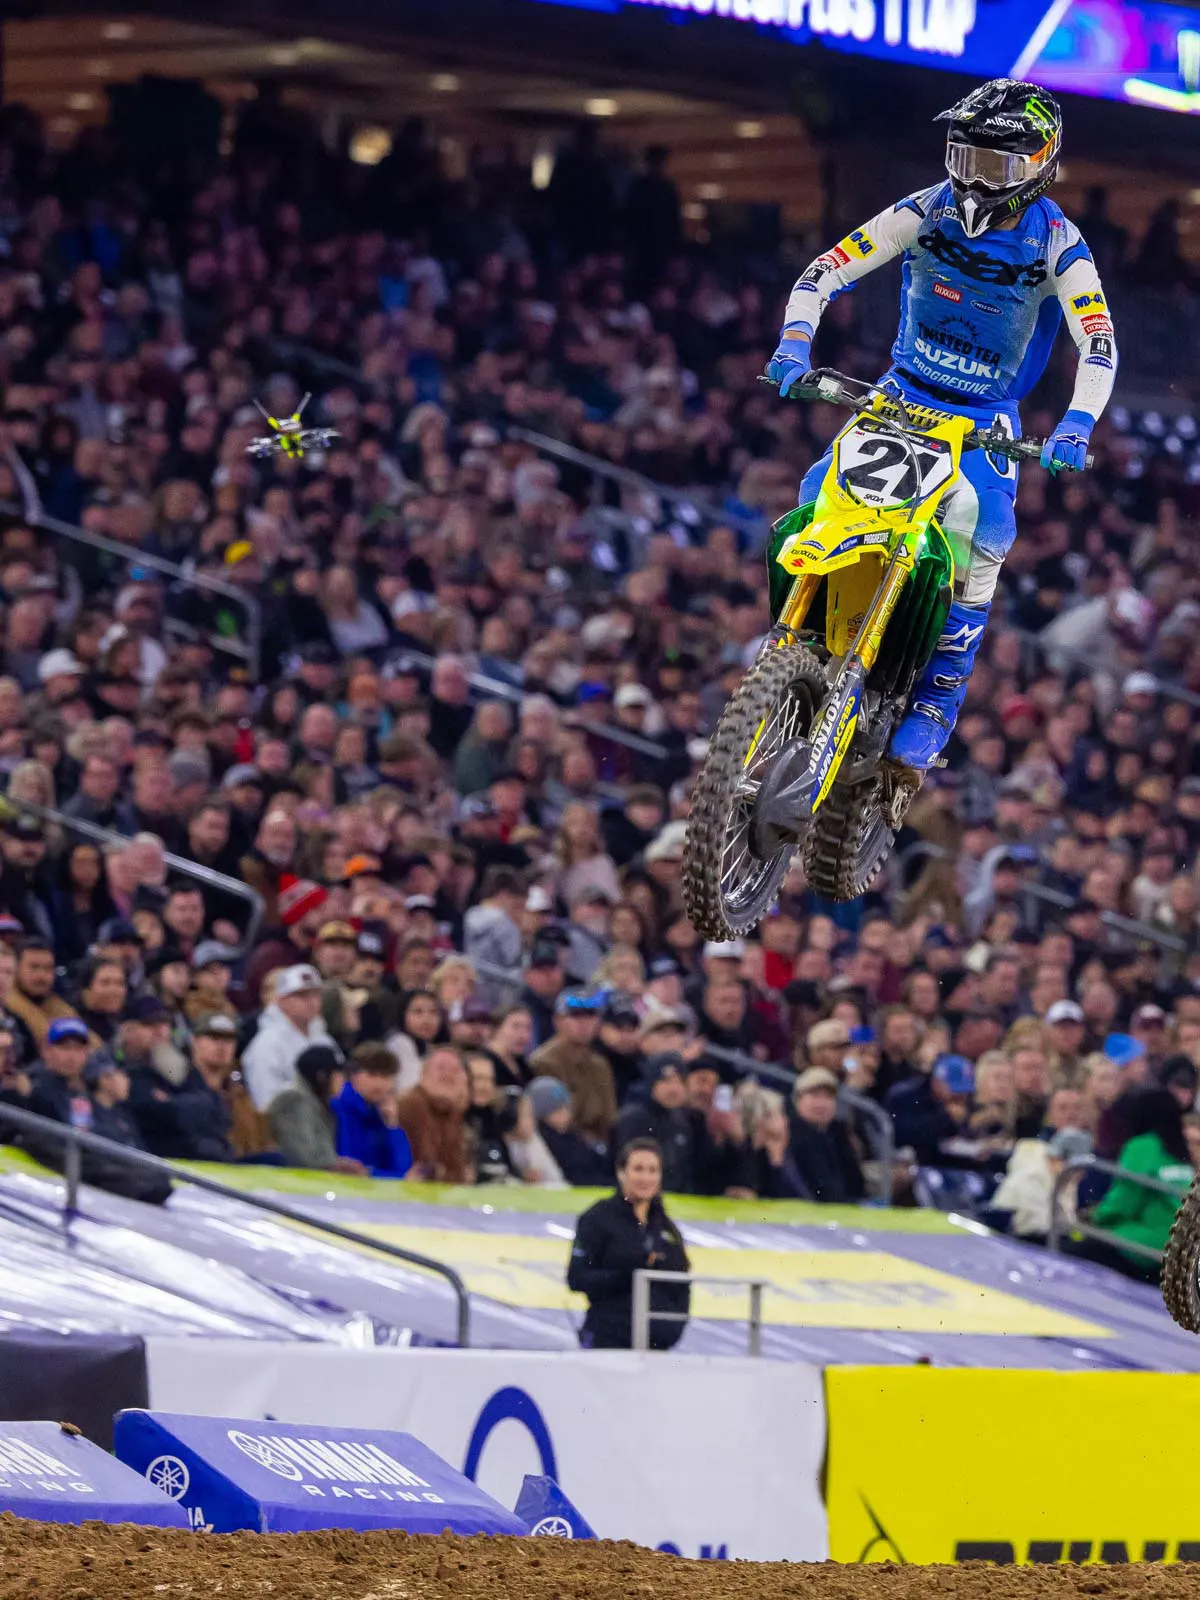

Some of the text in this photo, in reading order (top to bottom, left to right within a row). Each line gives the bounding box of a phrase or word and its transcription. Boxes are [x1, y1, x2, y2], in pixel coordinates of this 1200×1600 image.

[985, 118, 1025, 132] AIROH
[934, 284, 960, 301] DIXXON
[913, 357, 991, 394] PROGRESSIVE
[915, 337, 1001, 379] SUZUKI
[843, 438, 940, 500] 21
[791, 549, 820, 562] DIXXON
[809, 691, 841, 775] DUNLOP
[257, 1436, 432, 1487] YAMAHA
[302, 1484, 445, 1503] RACING
